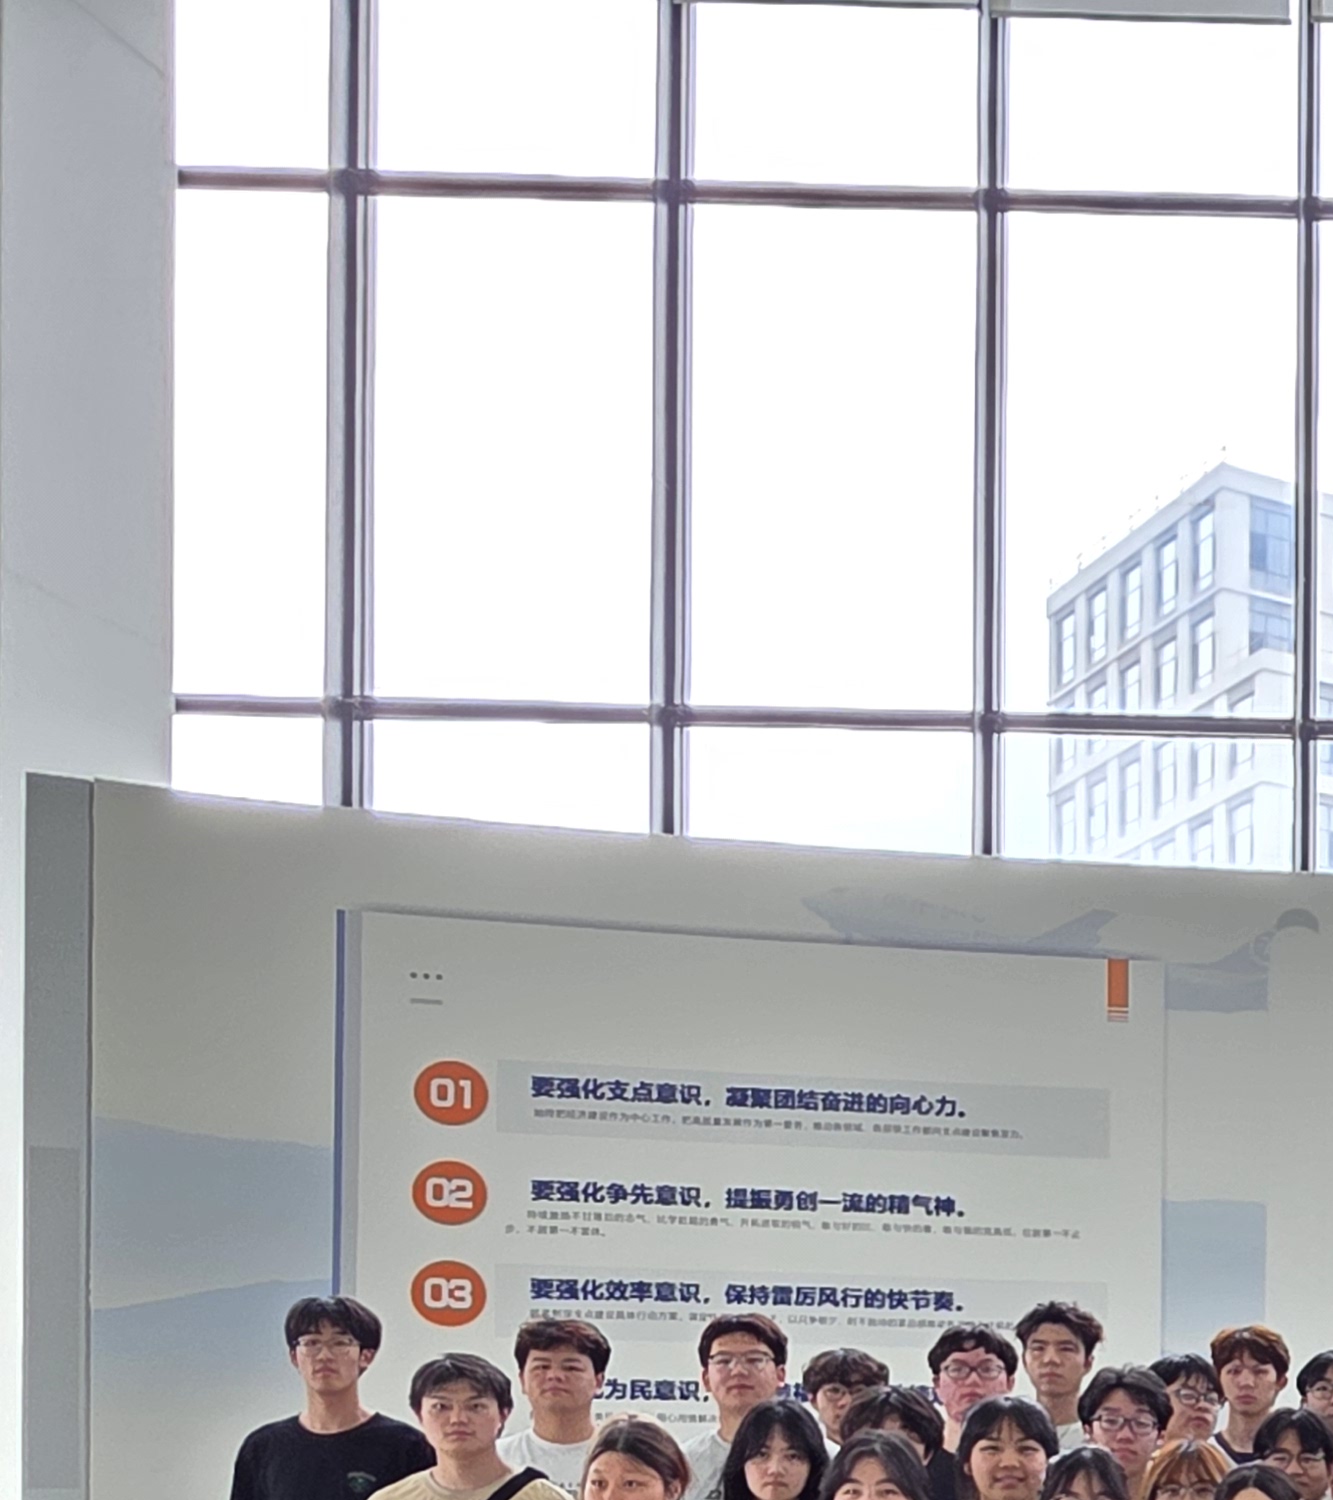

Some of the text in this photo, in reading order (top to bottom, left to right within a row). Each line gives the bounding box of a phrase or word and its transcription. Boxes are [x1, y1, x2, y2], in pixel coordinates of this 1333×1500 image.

[429, 1079, 474, 1110] 01
[424, 1180, 474, 1209] 02
[423, 1277, 474, 1310] 03
